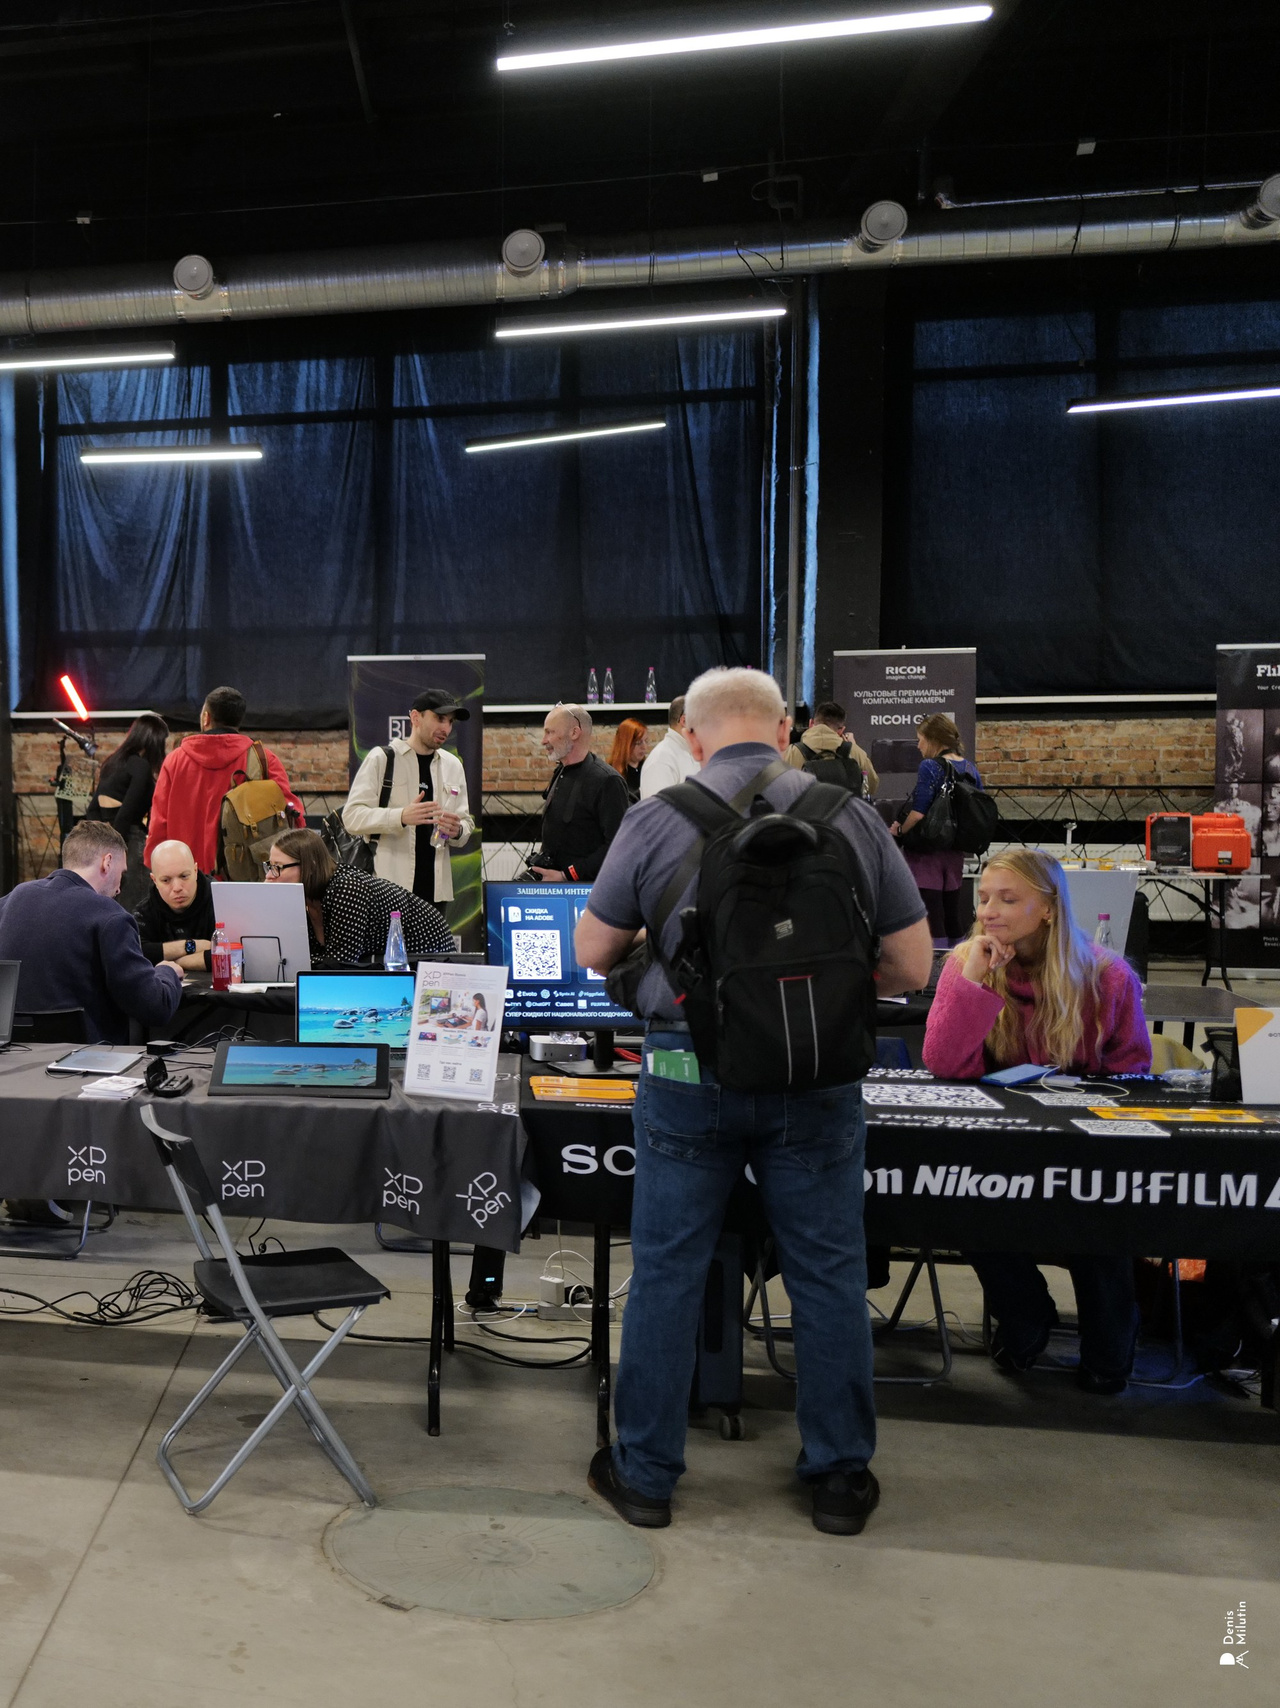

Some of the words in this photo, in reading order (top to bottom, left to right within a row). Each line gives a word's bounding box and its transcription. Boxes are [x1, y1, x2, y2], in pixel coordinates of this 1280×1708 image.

[885, 666, 926, 674] RICOH
[854, 690, 897, 698] КУЛЬТОВЫЕ
[898, 689, 955, 697] ПРЕМИАЛЬНЫЕ
[870, 715, 911, 725] RICOH
[422, 979, 440, 988] pen
[423, 971, 442, 980] XP
[67, 1146, 107, 1166] XP
[67, 1166, 106, 1186] pen
[222, 1160, 266, 1179] XP
[561, 1144, 636, 1176] SO
[912, 1164, 1036, 1200] Nikon
[1042, 1166, 1257, 1207] FUJIFILM
[222, 1181, 265, 1200] pen
[384, 1167, 423, 1195] XP
[455, 1172, 497, 1211] XP
[383, 1190, 420, 1215] pen
[471, 1191, 512, 1229] pen
